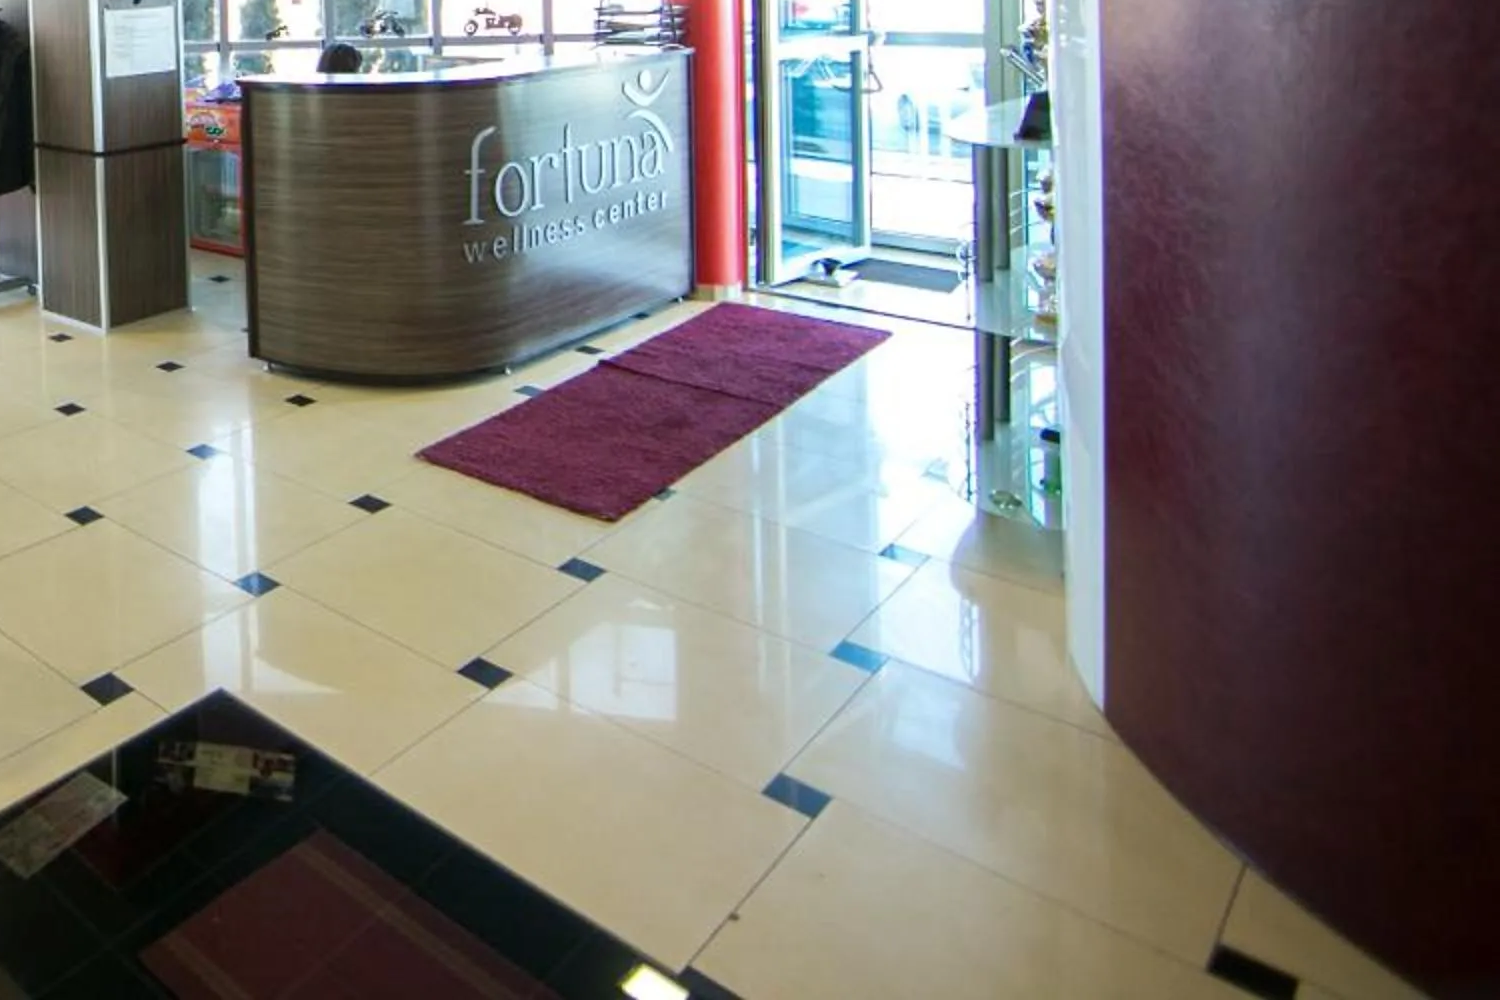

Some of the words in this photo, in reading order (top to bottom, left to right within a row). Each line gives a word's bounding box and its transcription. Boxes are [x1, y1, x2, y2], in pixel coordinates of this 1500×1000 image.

[463, 122, 666, 226] fortuna
[463, 215, 586, 265] wellness
[592, 190, 668, 231] center
